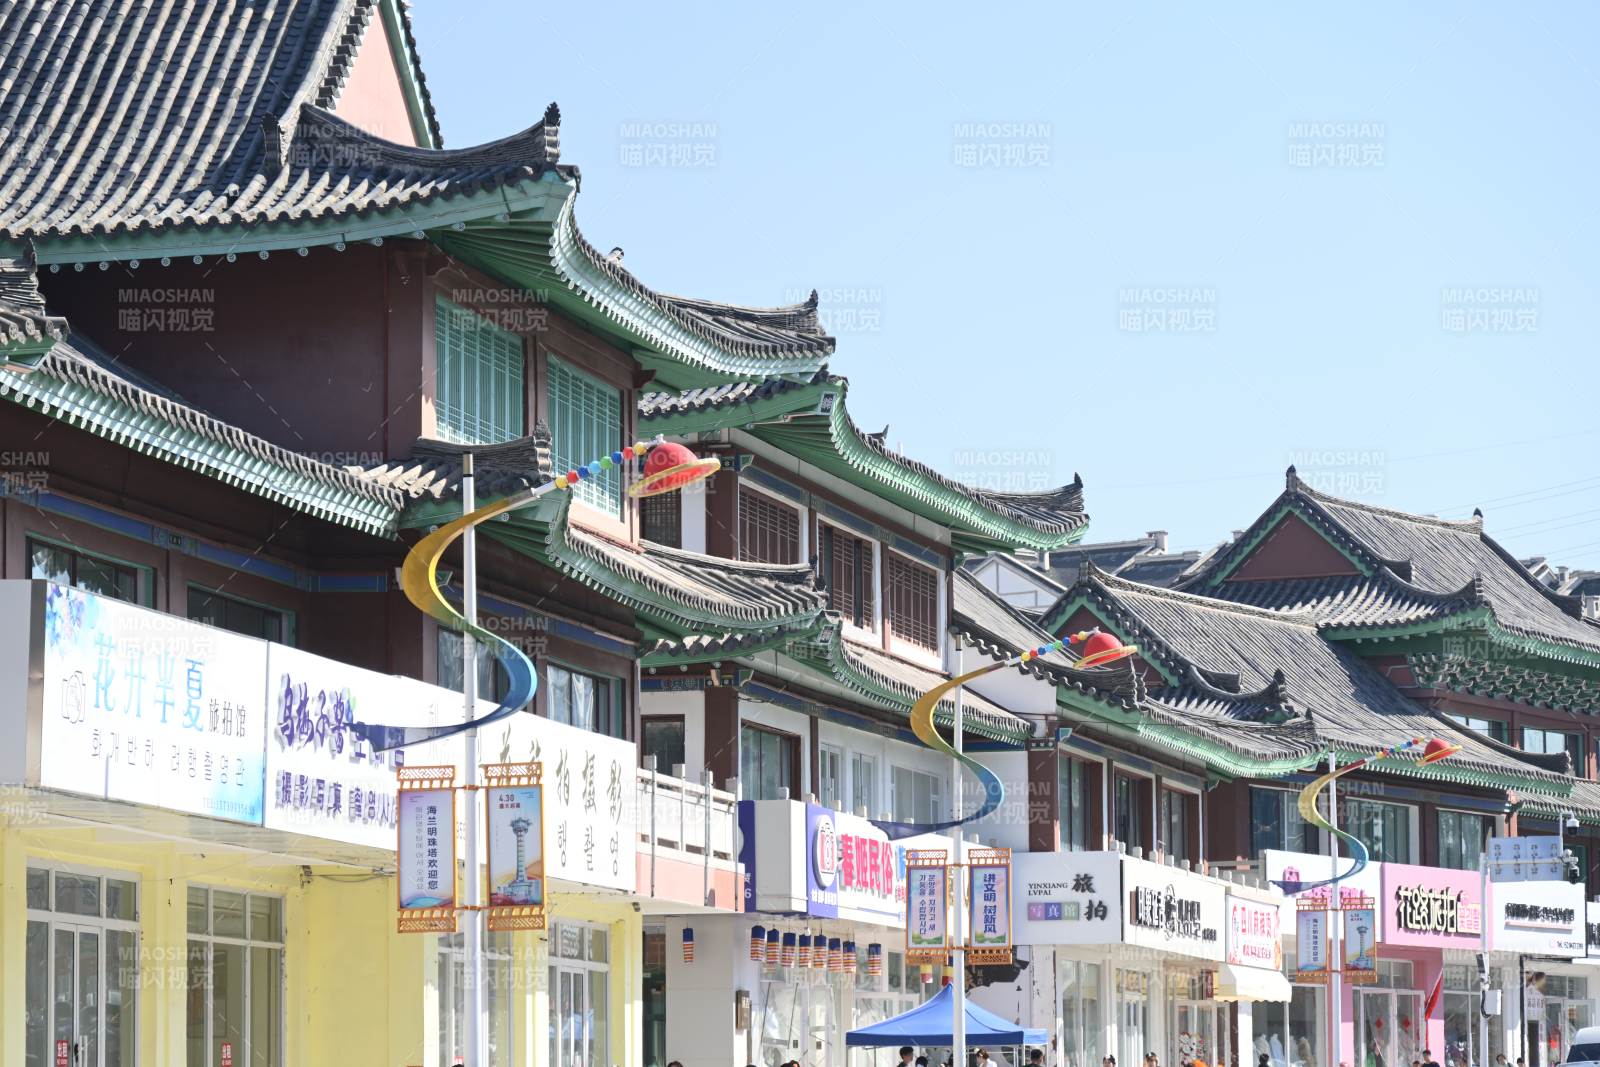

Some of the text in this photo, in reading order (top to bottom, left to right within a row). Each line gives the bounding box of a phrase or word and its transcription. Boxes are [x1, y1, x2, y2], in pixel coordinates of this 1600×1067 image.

[92, 632, 205, 732] 花开半夏
[208, 698, 247, 738] 旅拍馆
[281, 770, 342, 815] 摄影写真
[426, 805, 438, 890] 海兰明珠塔欢迎您
[840, 833, 894, 895] 春姬民俗
[983, 873, 997, 934] 讲文明 树新风
[1028, 882, 1068, 890] YINXIANG
[1028, 889, 1052, 897] LVPAI
[1071, 873, 1108, 921] 旅拍
[1398, 884, 1458, 933] 花路旅拍
